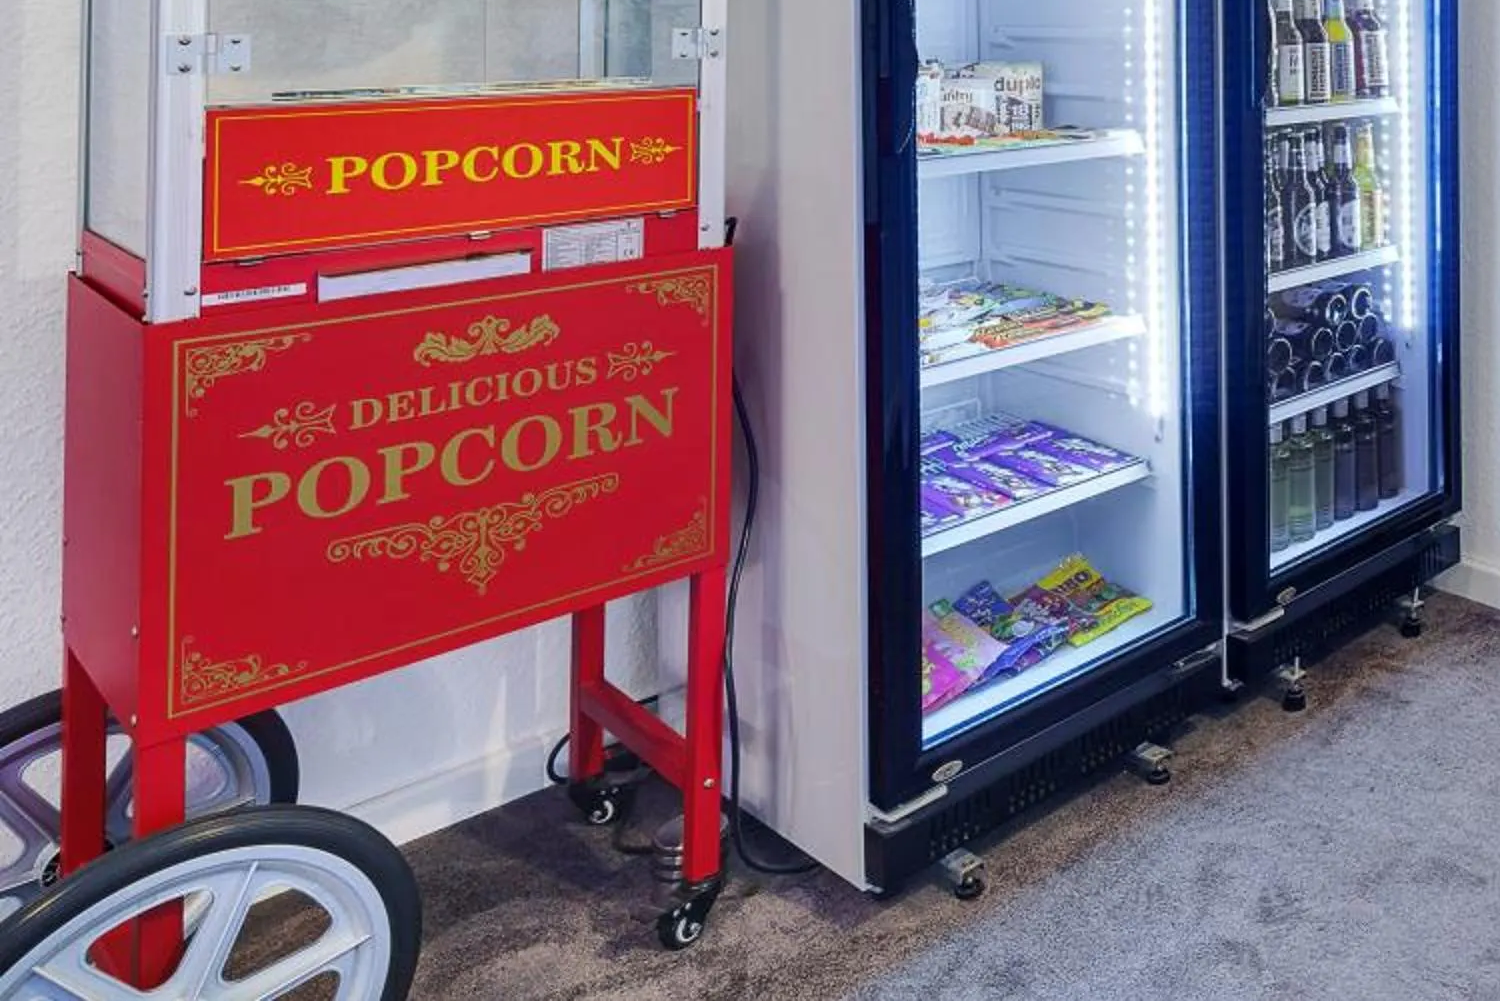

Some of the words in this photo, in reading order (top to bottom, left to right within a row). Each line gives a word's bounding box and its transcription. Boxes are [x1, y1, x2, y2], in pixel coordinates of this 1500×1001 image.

[325, 137, 625, 195] POPCORN
[348, 356, 598, 431] DELICIOUS
[223, 387, 680, 541] POPCORN
